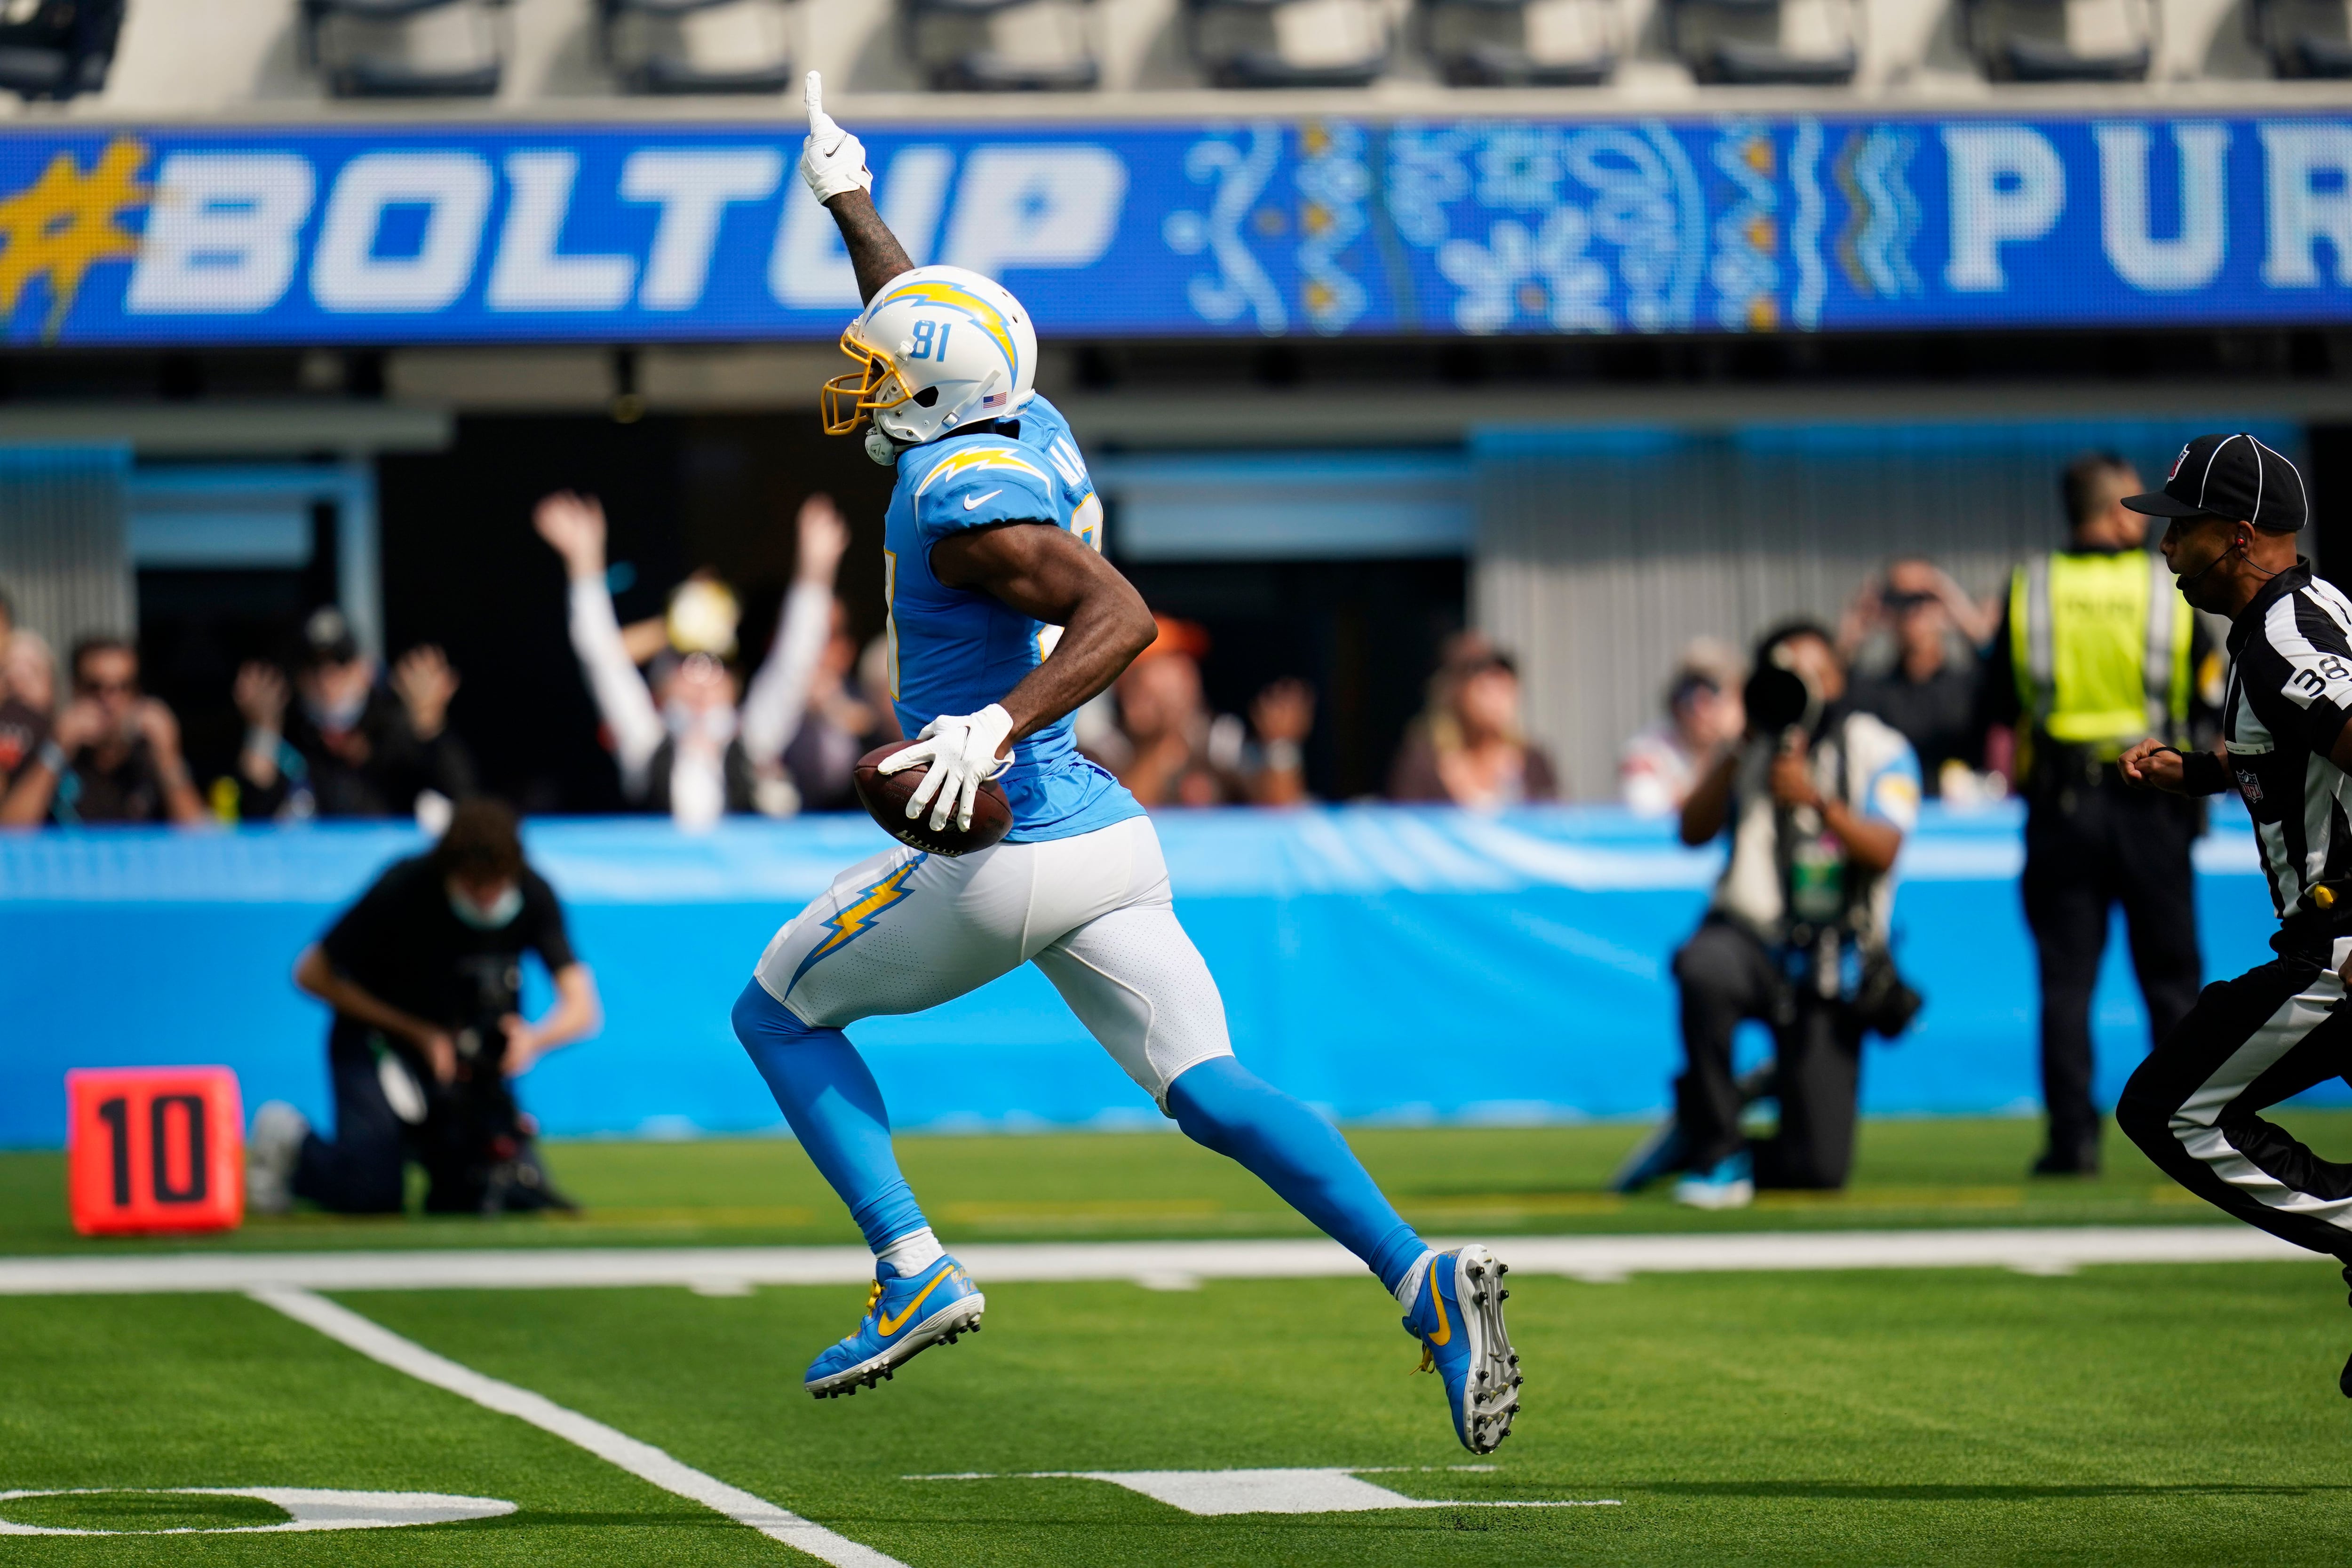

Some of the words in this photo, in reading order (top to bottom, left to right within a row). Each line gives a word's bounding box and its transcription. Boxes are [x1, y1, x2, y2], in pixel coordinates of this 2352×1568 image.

[910, 319, 952, 362] 81
[2293, 655, 2350, 698] 38
[99, 1095, 206, 1207] 10
